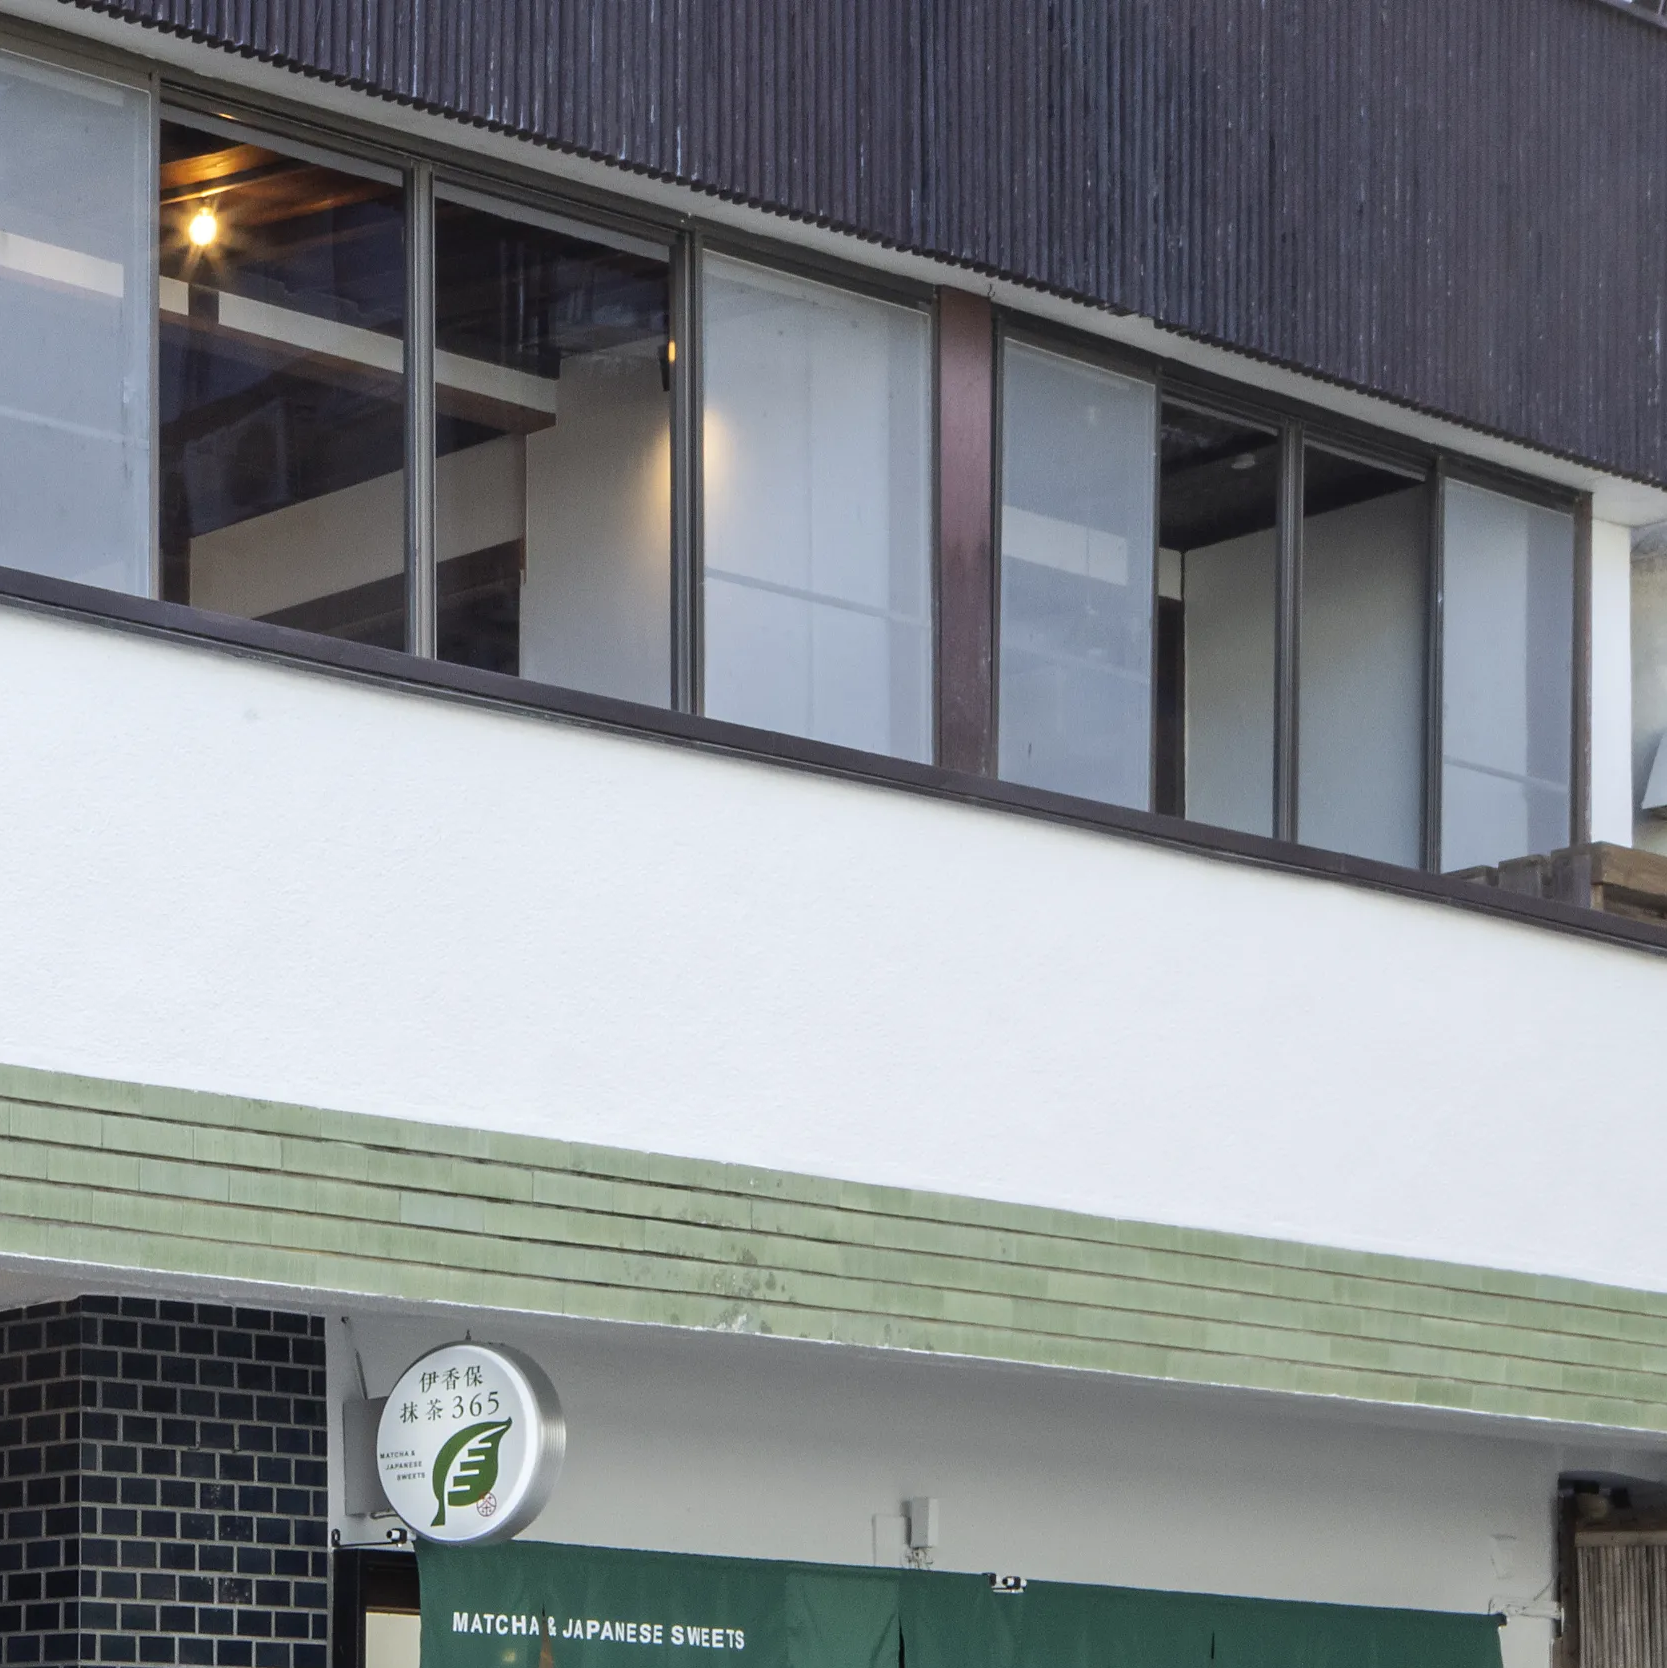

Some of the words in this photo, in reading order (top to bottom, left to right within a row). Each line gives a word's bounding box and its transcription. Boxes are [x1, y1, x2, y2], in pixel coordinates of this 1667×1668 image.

[419, 1365, 483, 1394] 伊香保
[379, 1450, 409, 1460] MATCHA
[384, 1460, 422, 1471] JAPANESE
[396, 1472, 426, 1482] SWEETS
[453, 1612, 539, 1635] MATCHA
[548, 1617, 556, 1636] &
[563, 1619, 662, 1644] JAPANESE
[671, 1626, 744, 1649] SWEETS
